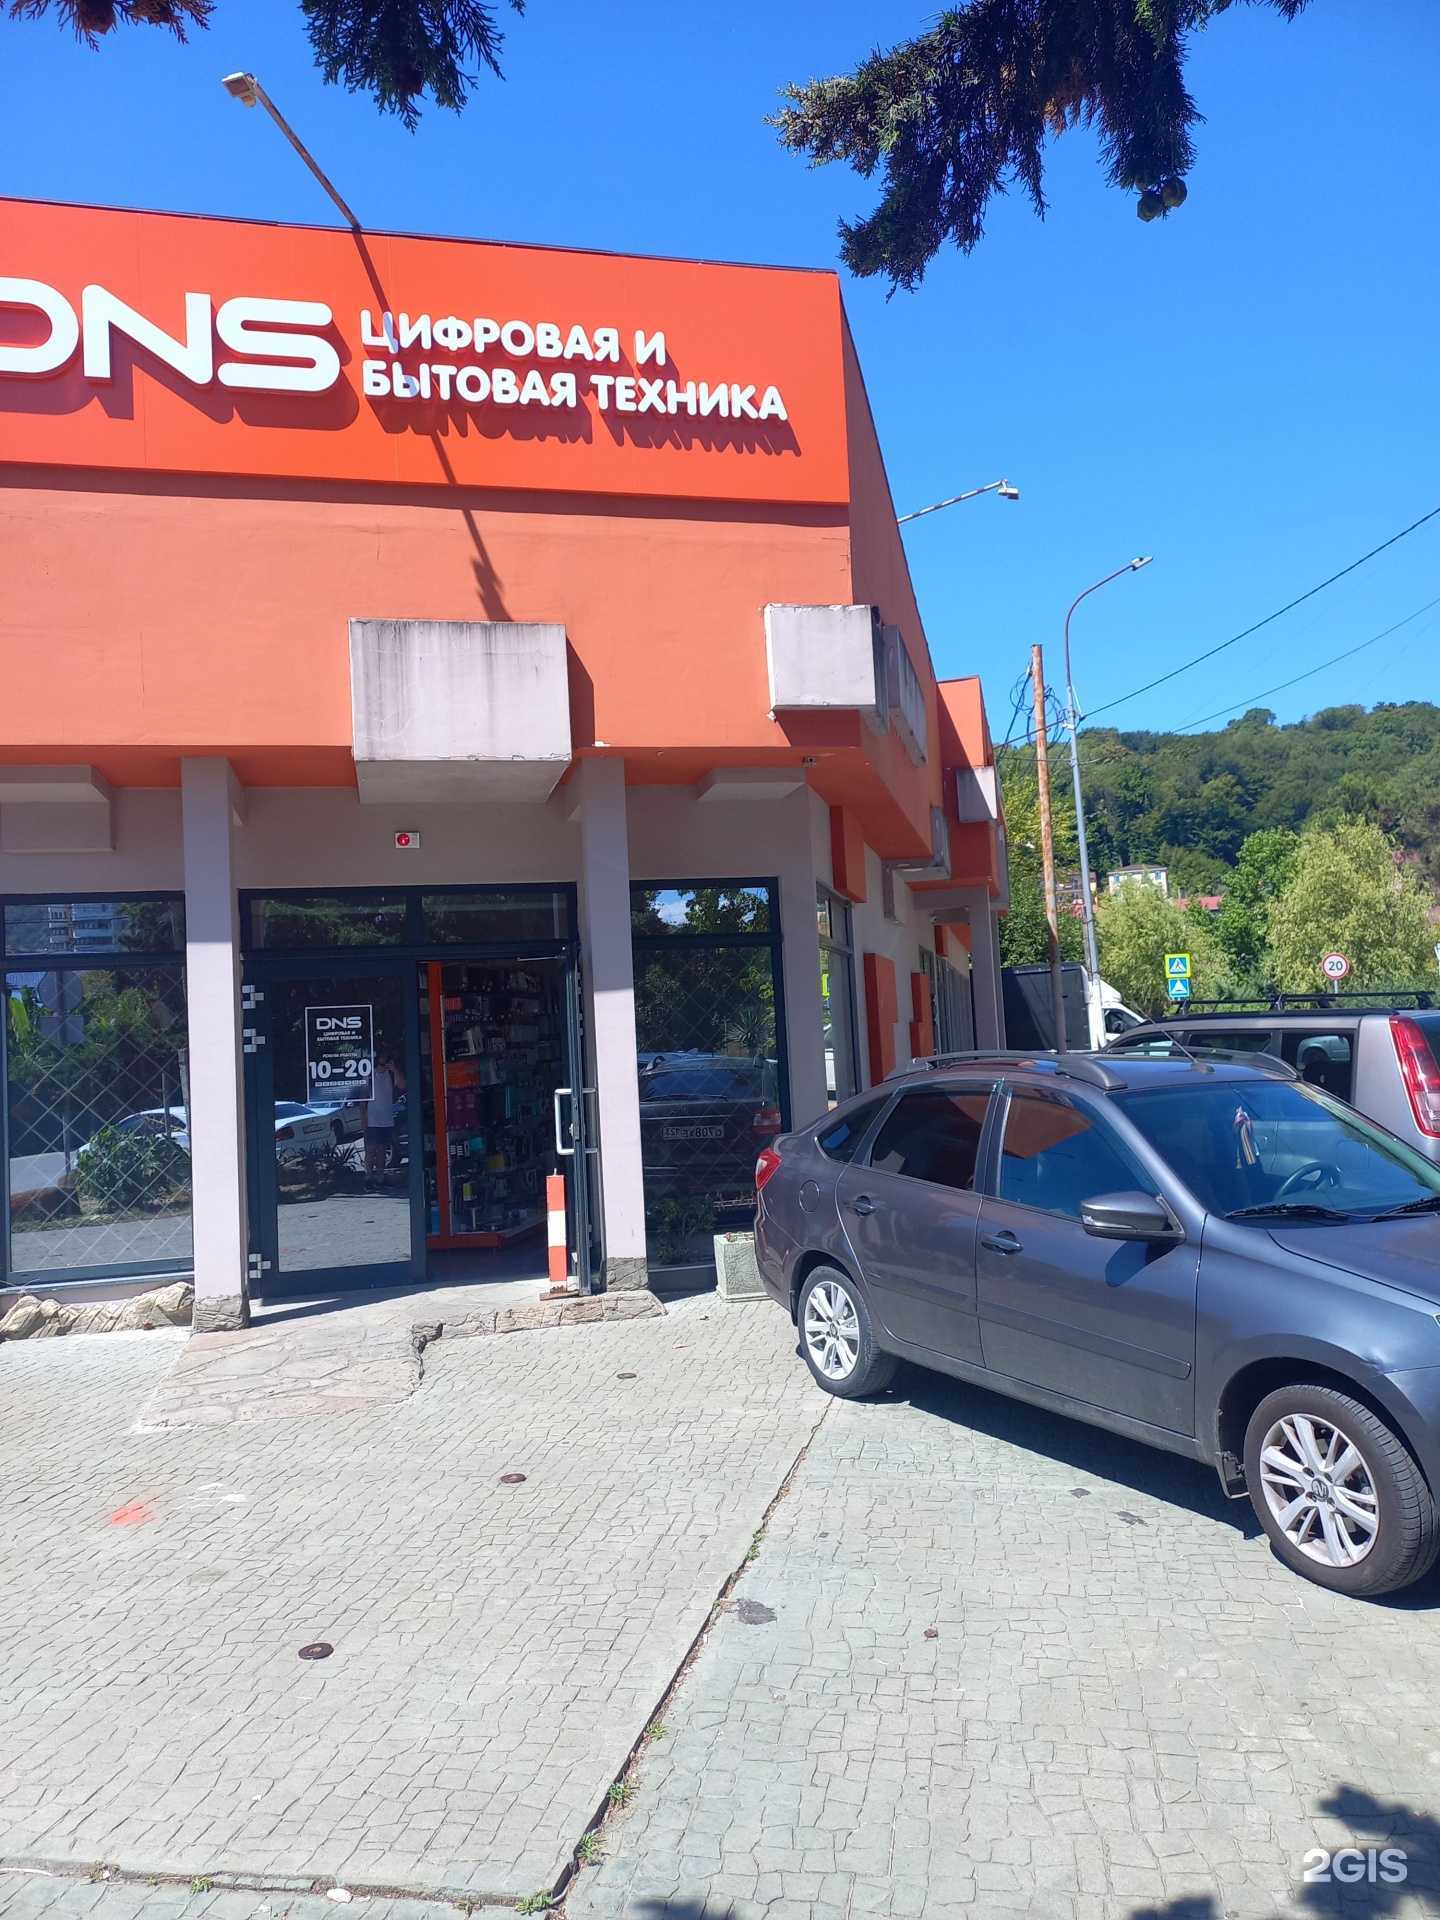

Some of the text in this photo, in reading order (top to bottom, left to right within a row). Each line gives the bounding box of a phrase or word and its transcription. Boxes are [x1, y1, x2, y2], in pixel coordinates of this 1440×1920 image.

[360, 309, 667, 366] ЦИФРОВАЯ И
[362, 359, 788, 421] БЫТОВАЯ ТЕХНИКА
[1328, 961, 1343, 971] 20
[316, 1016, 362, 1030] DNS
